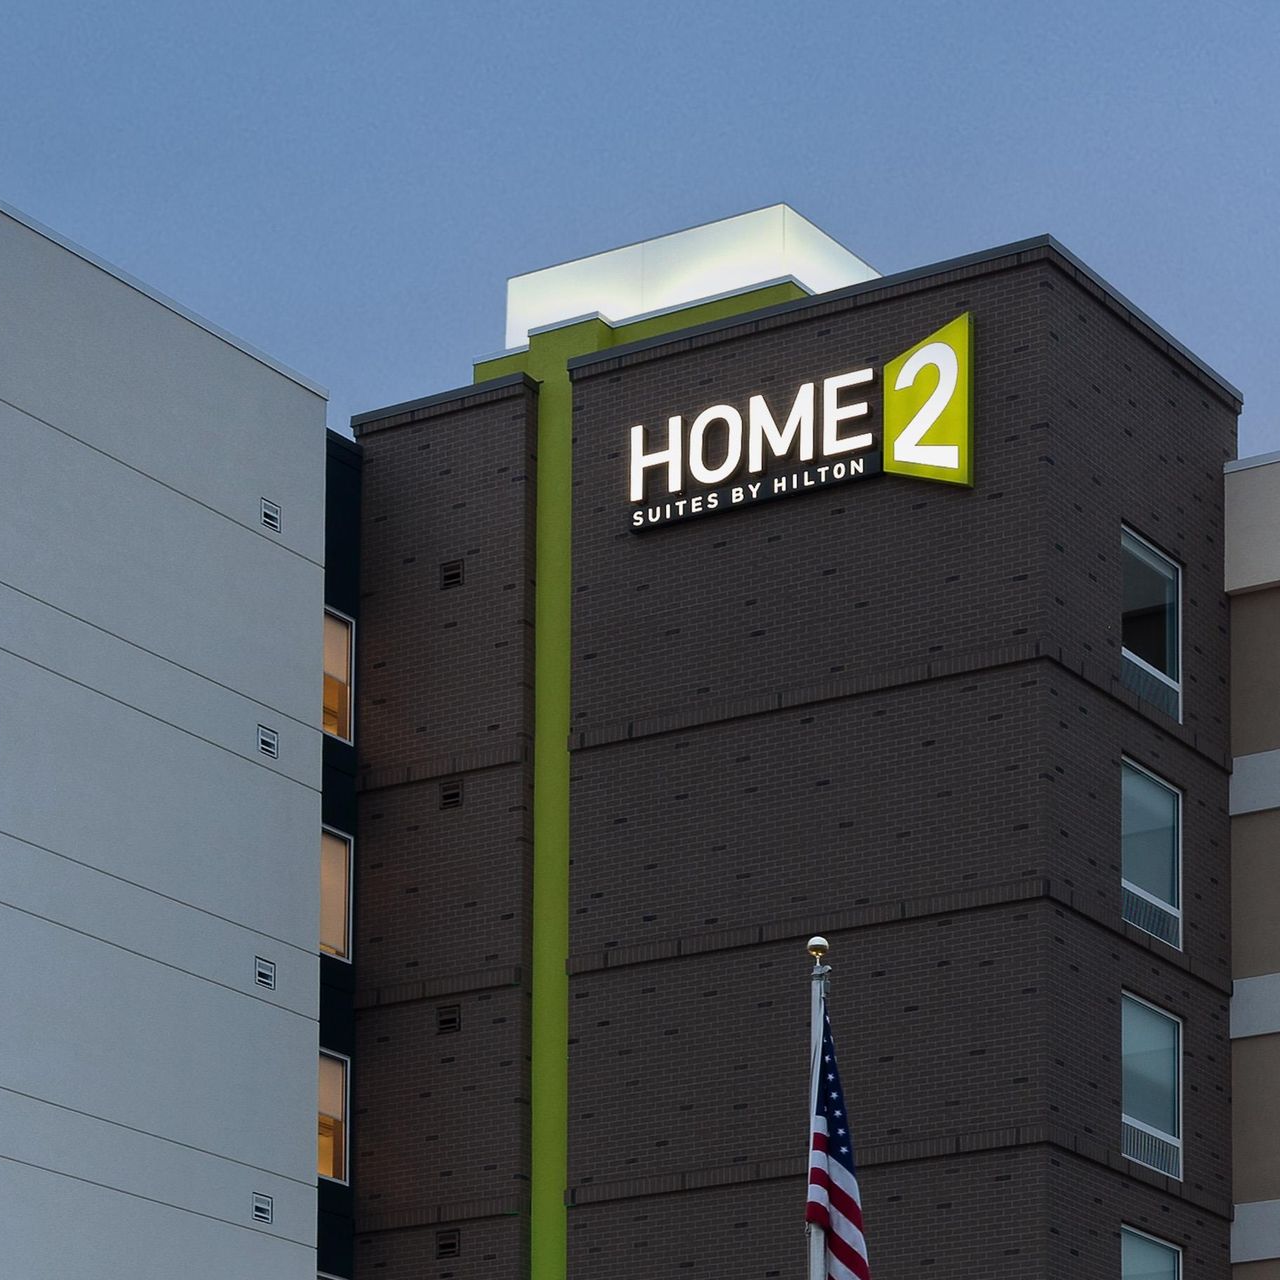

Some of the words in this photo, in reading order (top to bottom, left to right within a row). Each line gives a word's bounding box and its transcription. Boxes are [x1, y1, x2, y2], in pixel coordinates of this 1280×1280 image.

[629, 367, 874, 502] HOME
[893, 341, 960, 470] 2
[632, 491, 720, 527] SUITES
[731, 482, 762, 504] BY
[773, 457, 865, 494] HILTON
